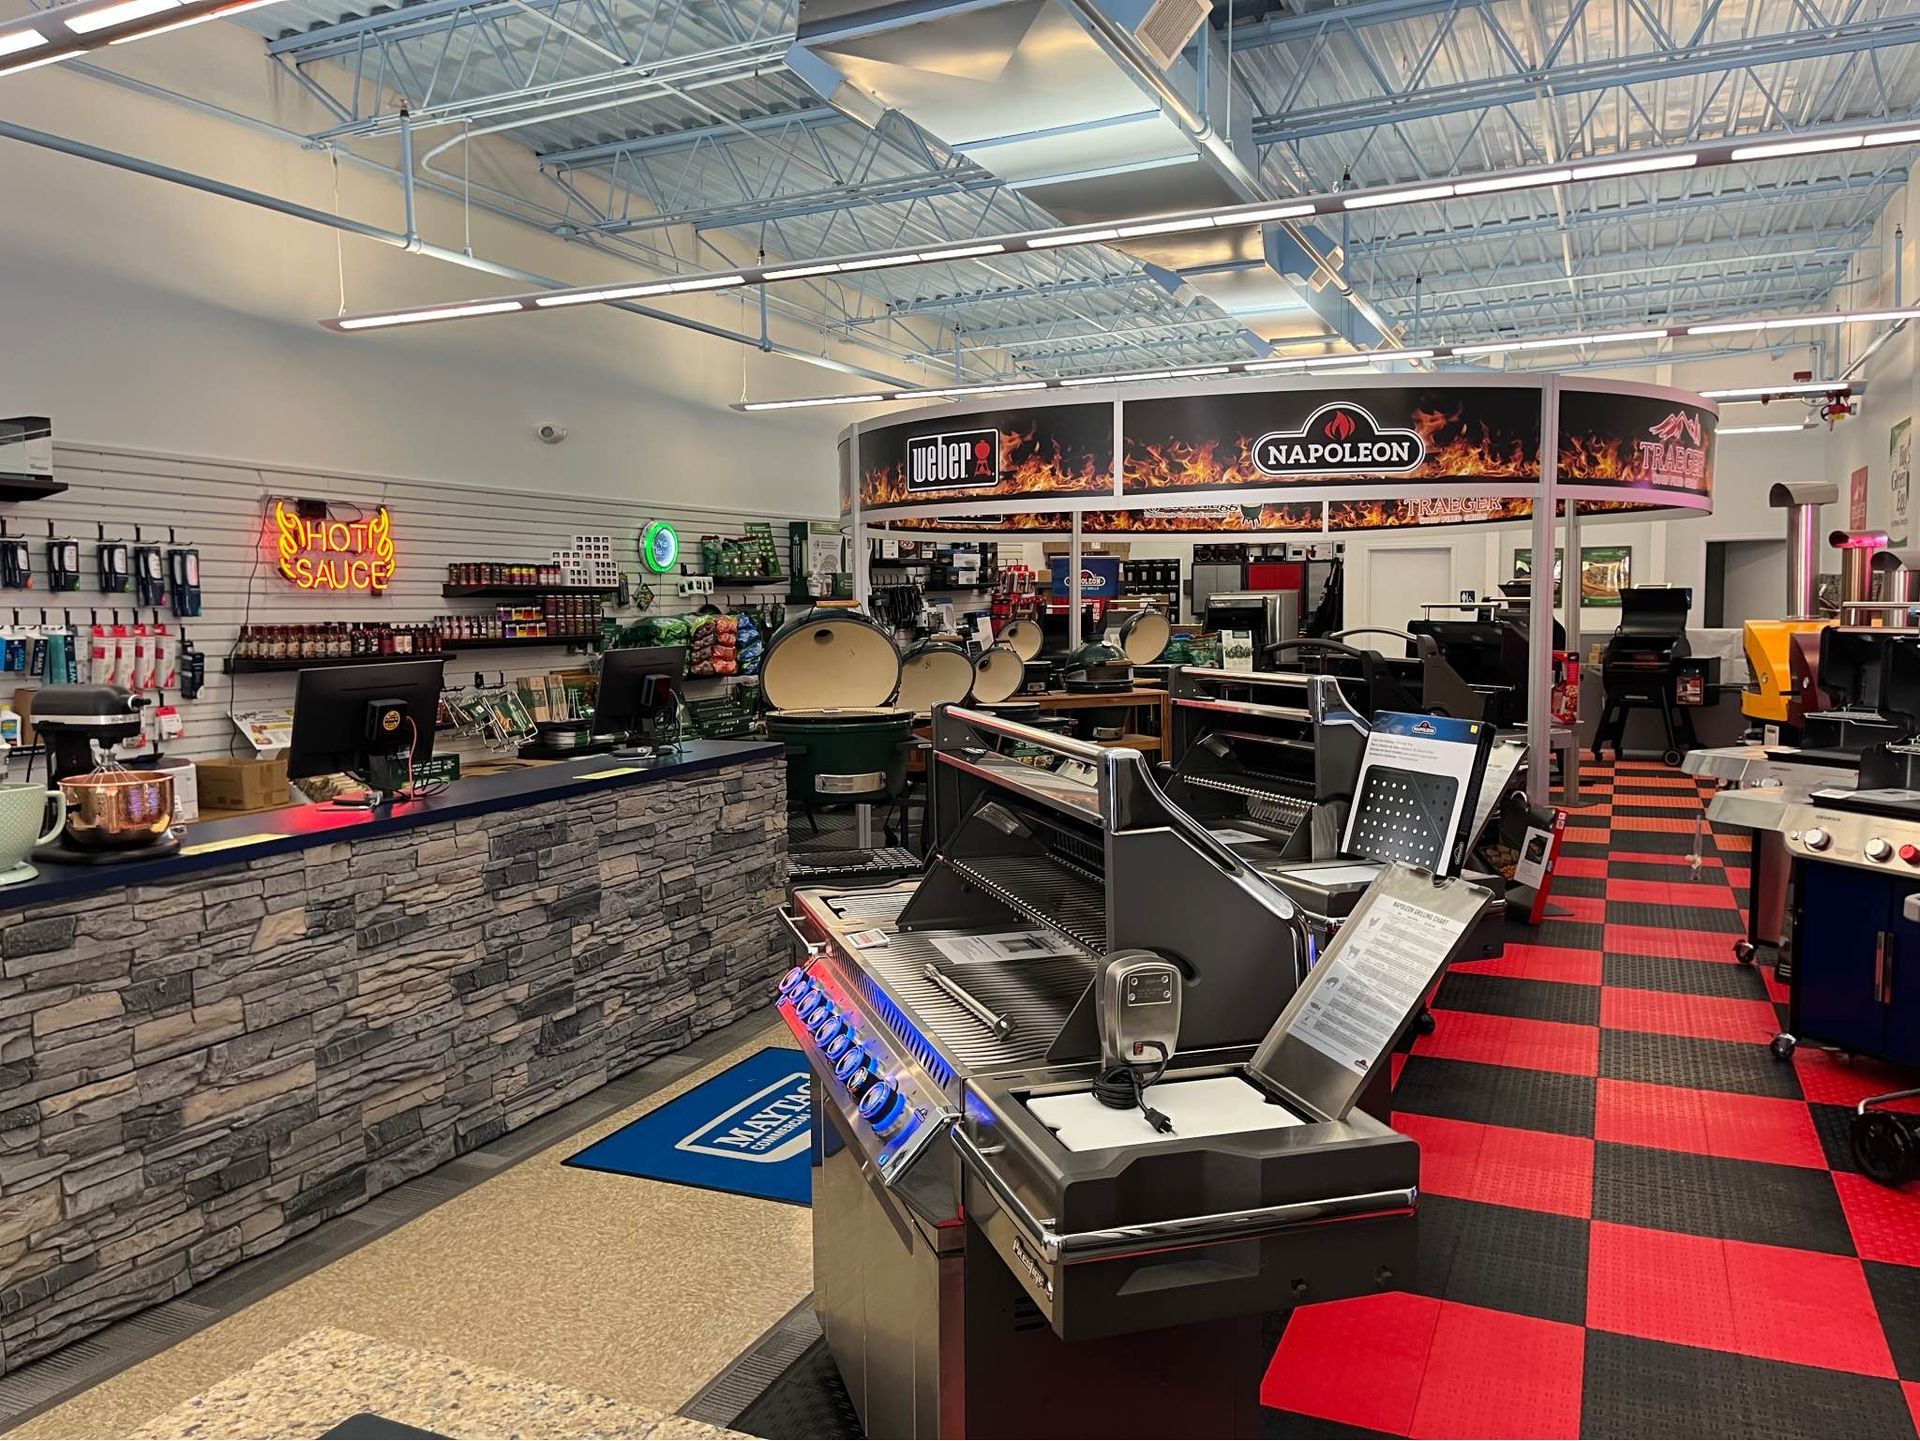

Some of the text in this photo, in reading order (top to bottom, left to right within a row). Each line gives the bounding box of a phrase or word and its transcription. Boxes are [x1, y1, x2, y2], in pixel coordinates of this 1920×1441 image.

[912, 436, 971, 482] weber
[1267, 442, 1410, 465] NAPOLEON
[1404, 497, 1502, 517] TRAEGER
[306, 520, 368, 553] HOT
[296, 558, 388, 589] SAUCE
